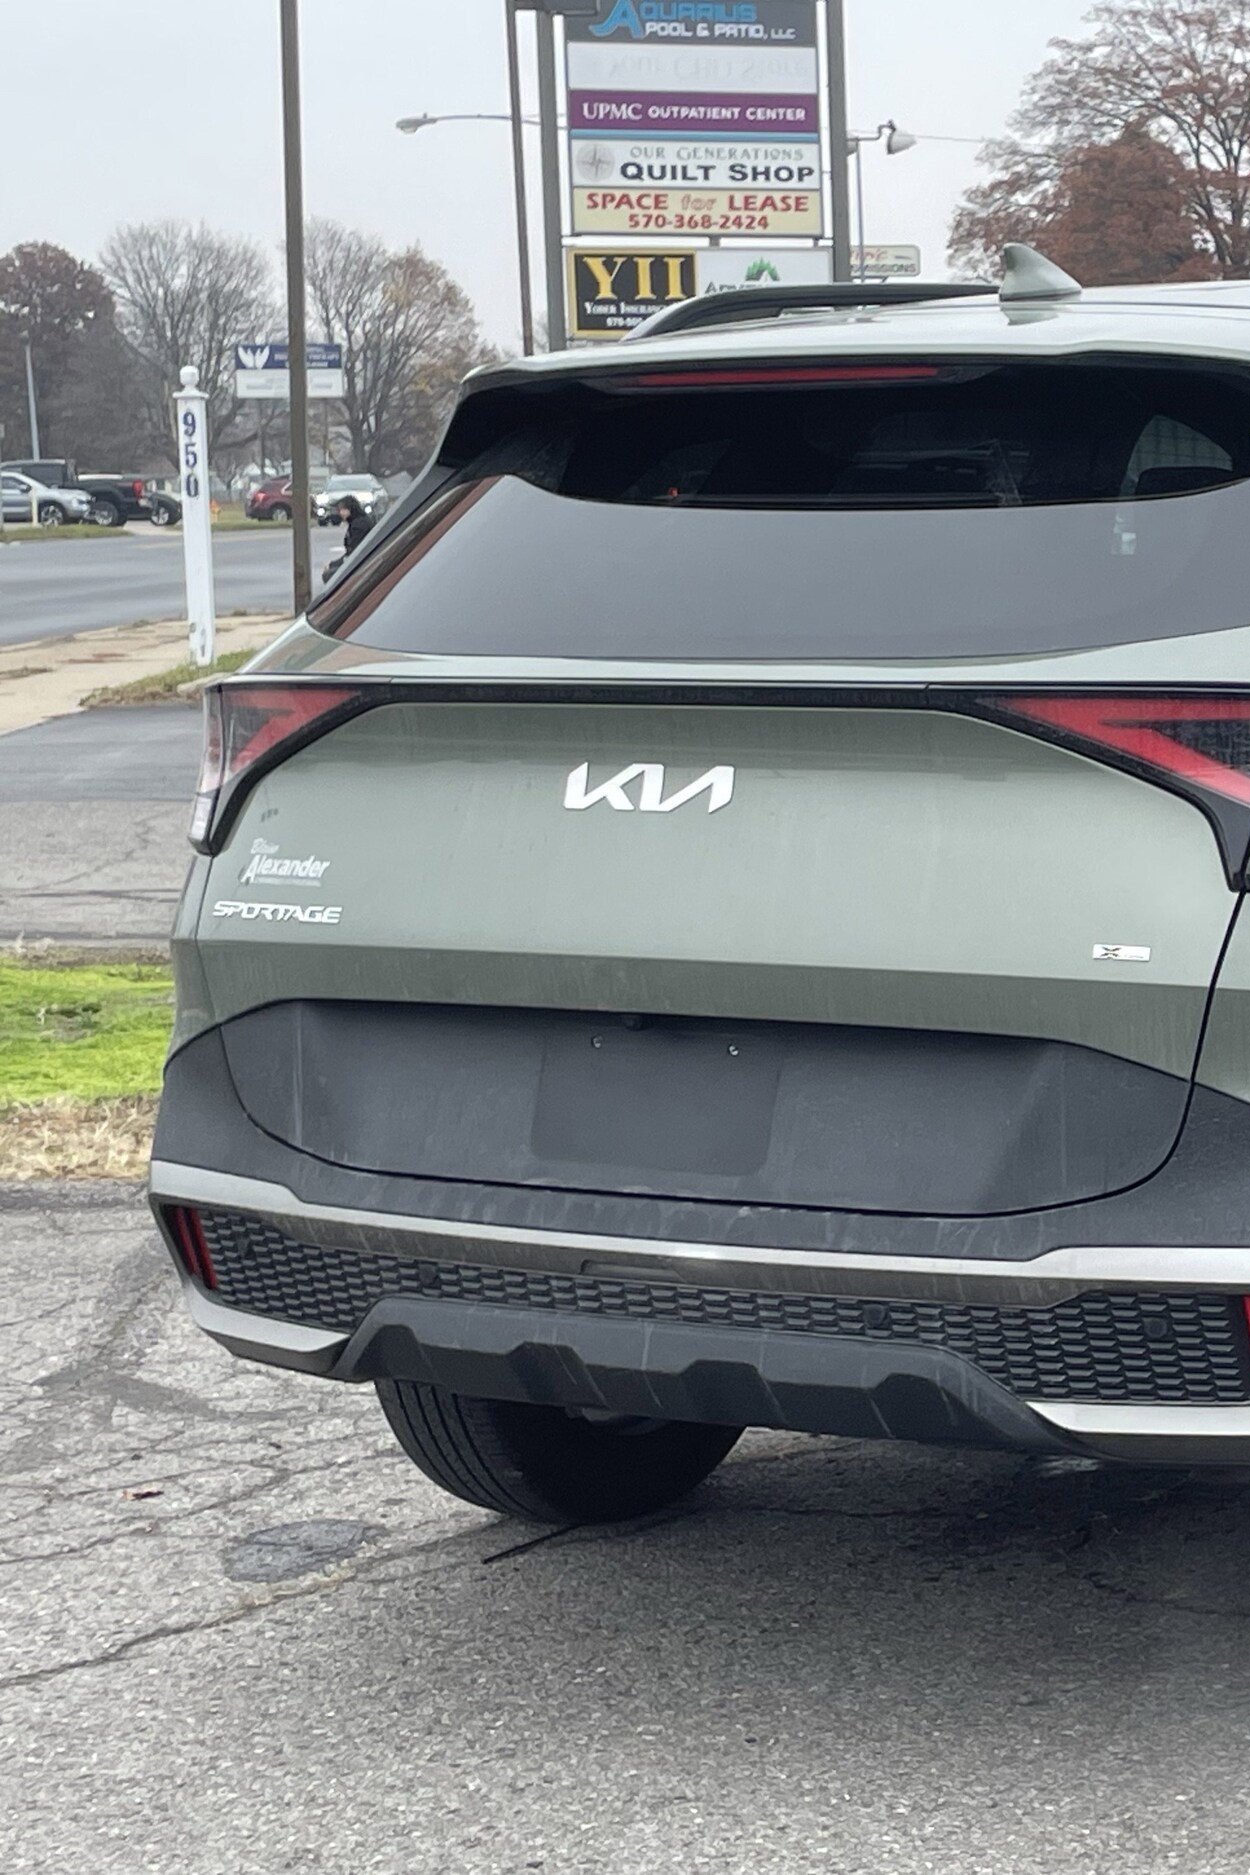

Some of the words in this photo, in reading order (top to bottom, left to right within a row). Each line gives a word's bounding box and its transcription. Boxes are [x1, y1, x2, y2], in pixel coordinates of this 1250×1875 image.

[646, 22, 693, 37] POOL
[696, 22, 710, 37] &
[771, 27, 796, 39] LLC
[583, 102, 642, 120] UPMC
[648, 105, 741, 120] OUTPATIENT
[746, 106, 806, 121] CENTER
[630, 146, 666, 159] OUR
[676, 147, 804, 161] GENERATIONS
[620, 162, 716, 182] QUILT
[729, 164, 815, 183] SHOP
[587, 193, 668, 210] SPACE
[680, 194, 717, 211] for
[728, 195, 809, 212] LEASE
[628, 214, 769, 230] 570-368-2424
[583, 257, 688, 300] YII
[183, 412, 199, 497] 950
[563, 761, 735, 814] KIA
[241, 855, 331, 883] Alexander
[213, 901, 342, 923] SPORTAGE
